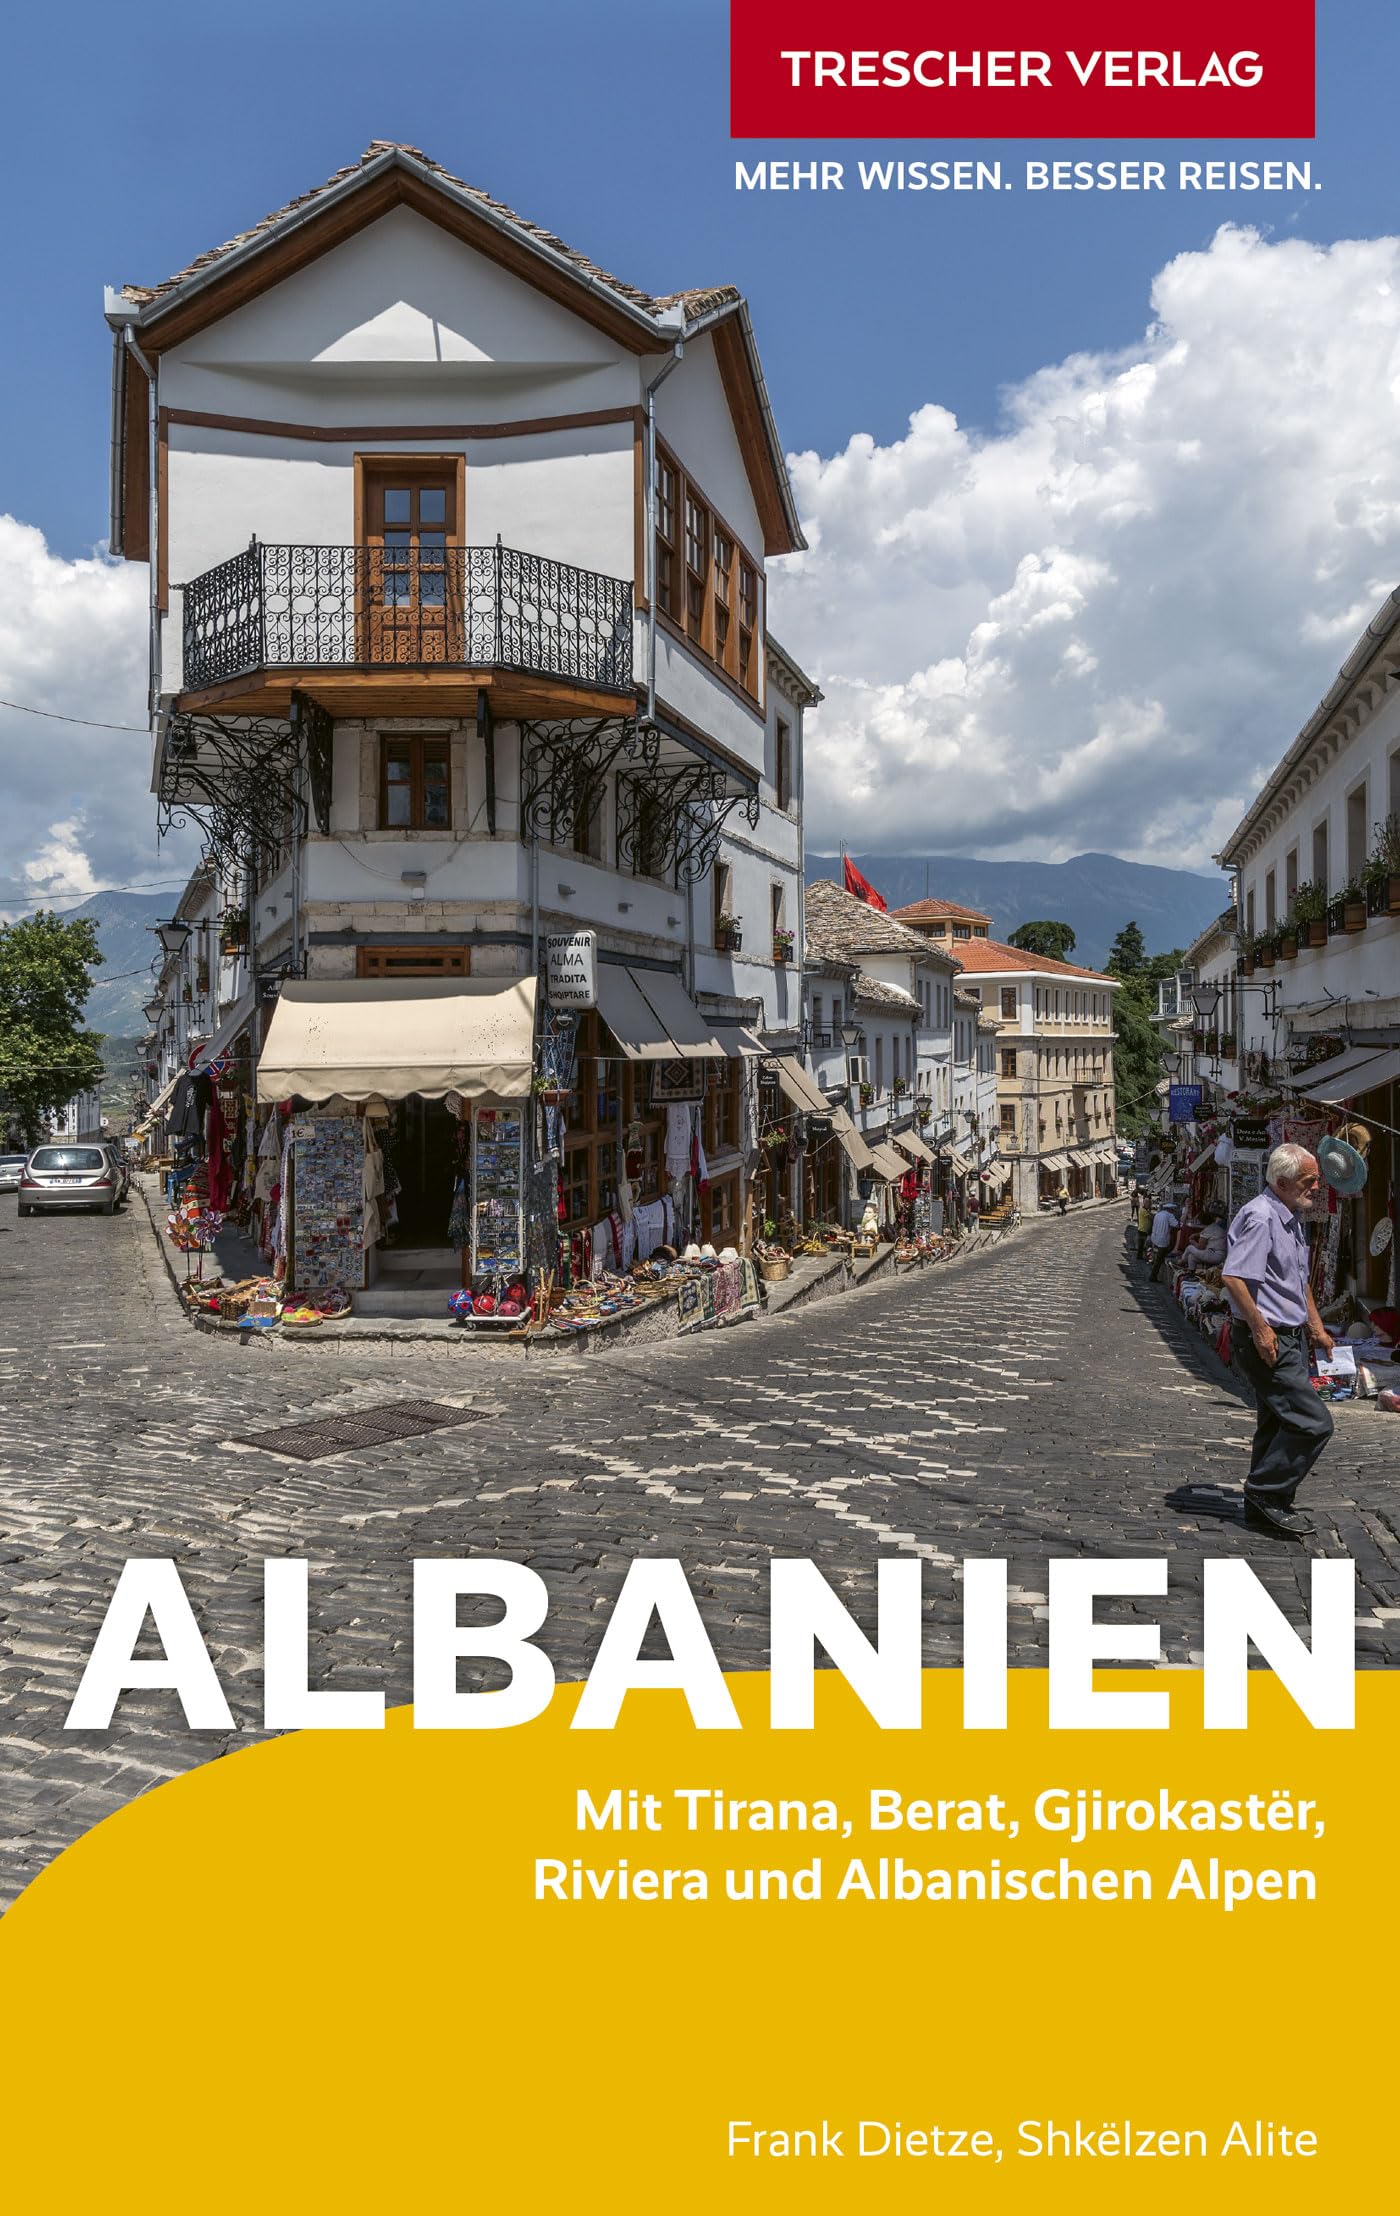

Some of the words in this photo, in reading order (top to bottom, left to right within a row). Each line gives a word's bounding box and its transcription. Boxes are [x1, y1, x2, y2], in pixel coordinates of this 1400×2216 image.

[547, 937, 590, 948] SOUVENIR
[551, 953, 583, 966] ALMA
[550, 974, 587, 984] TRADITA
[549, 990, 590, 1000] SHQIPTARE
